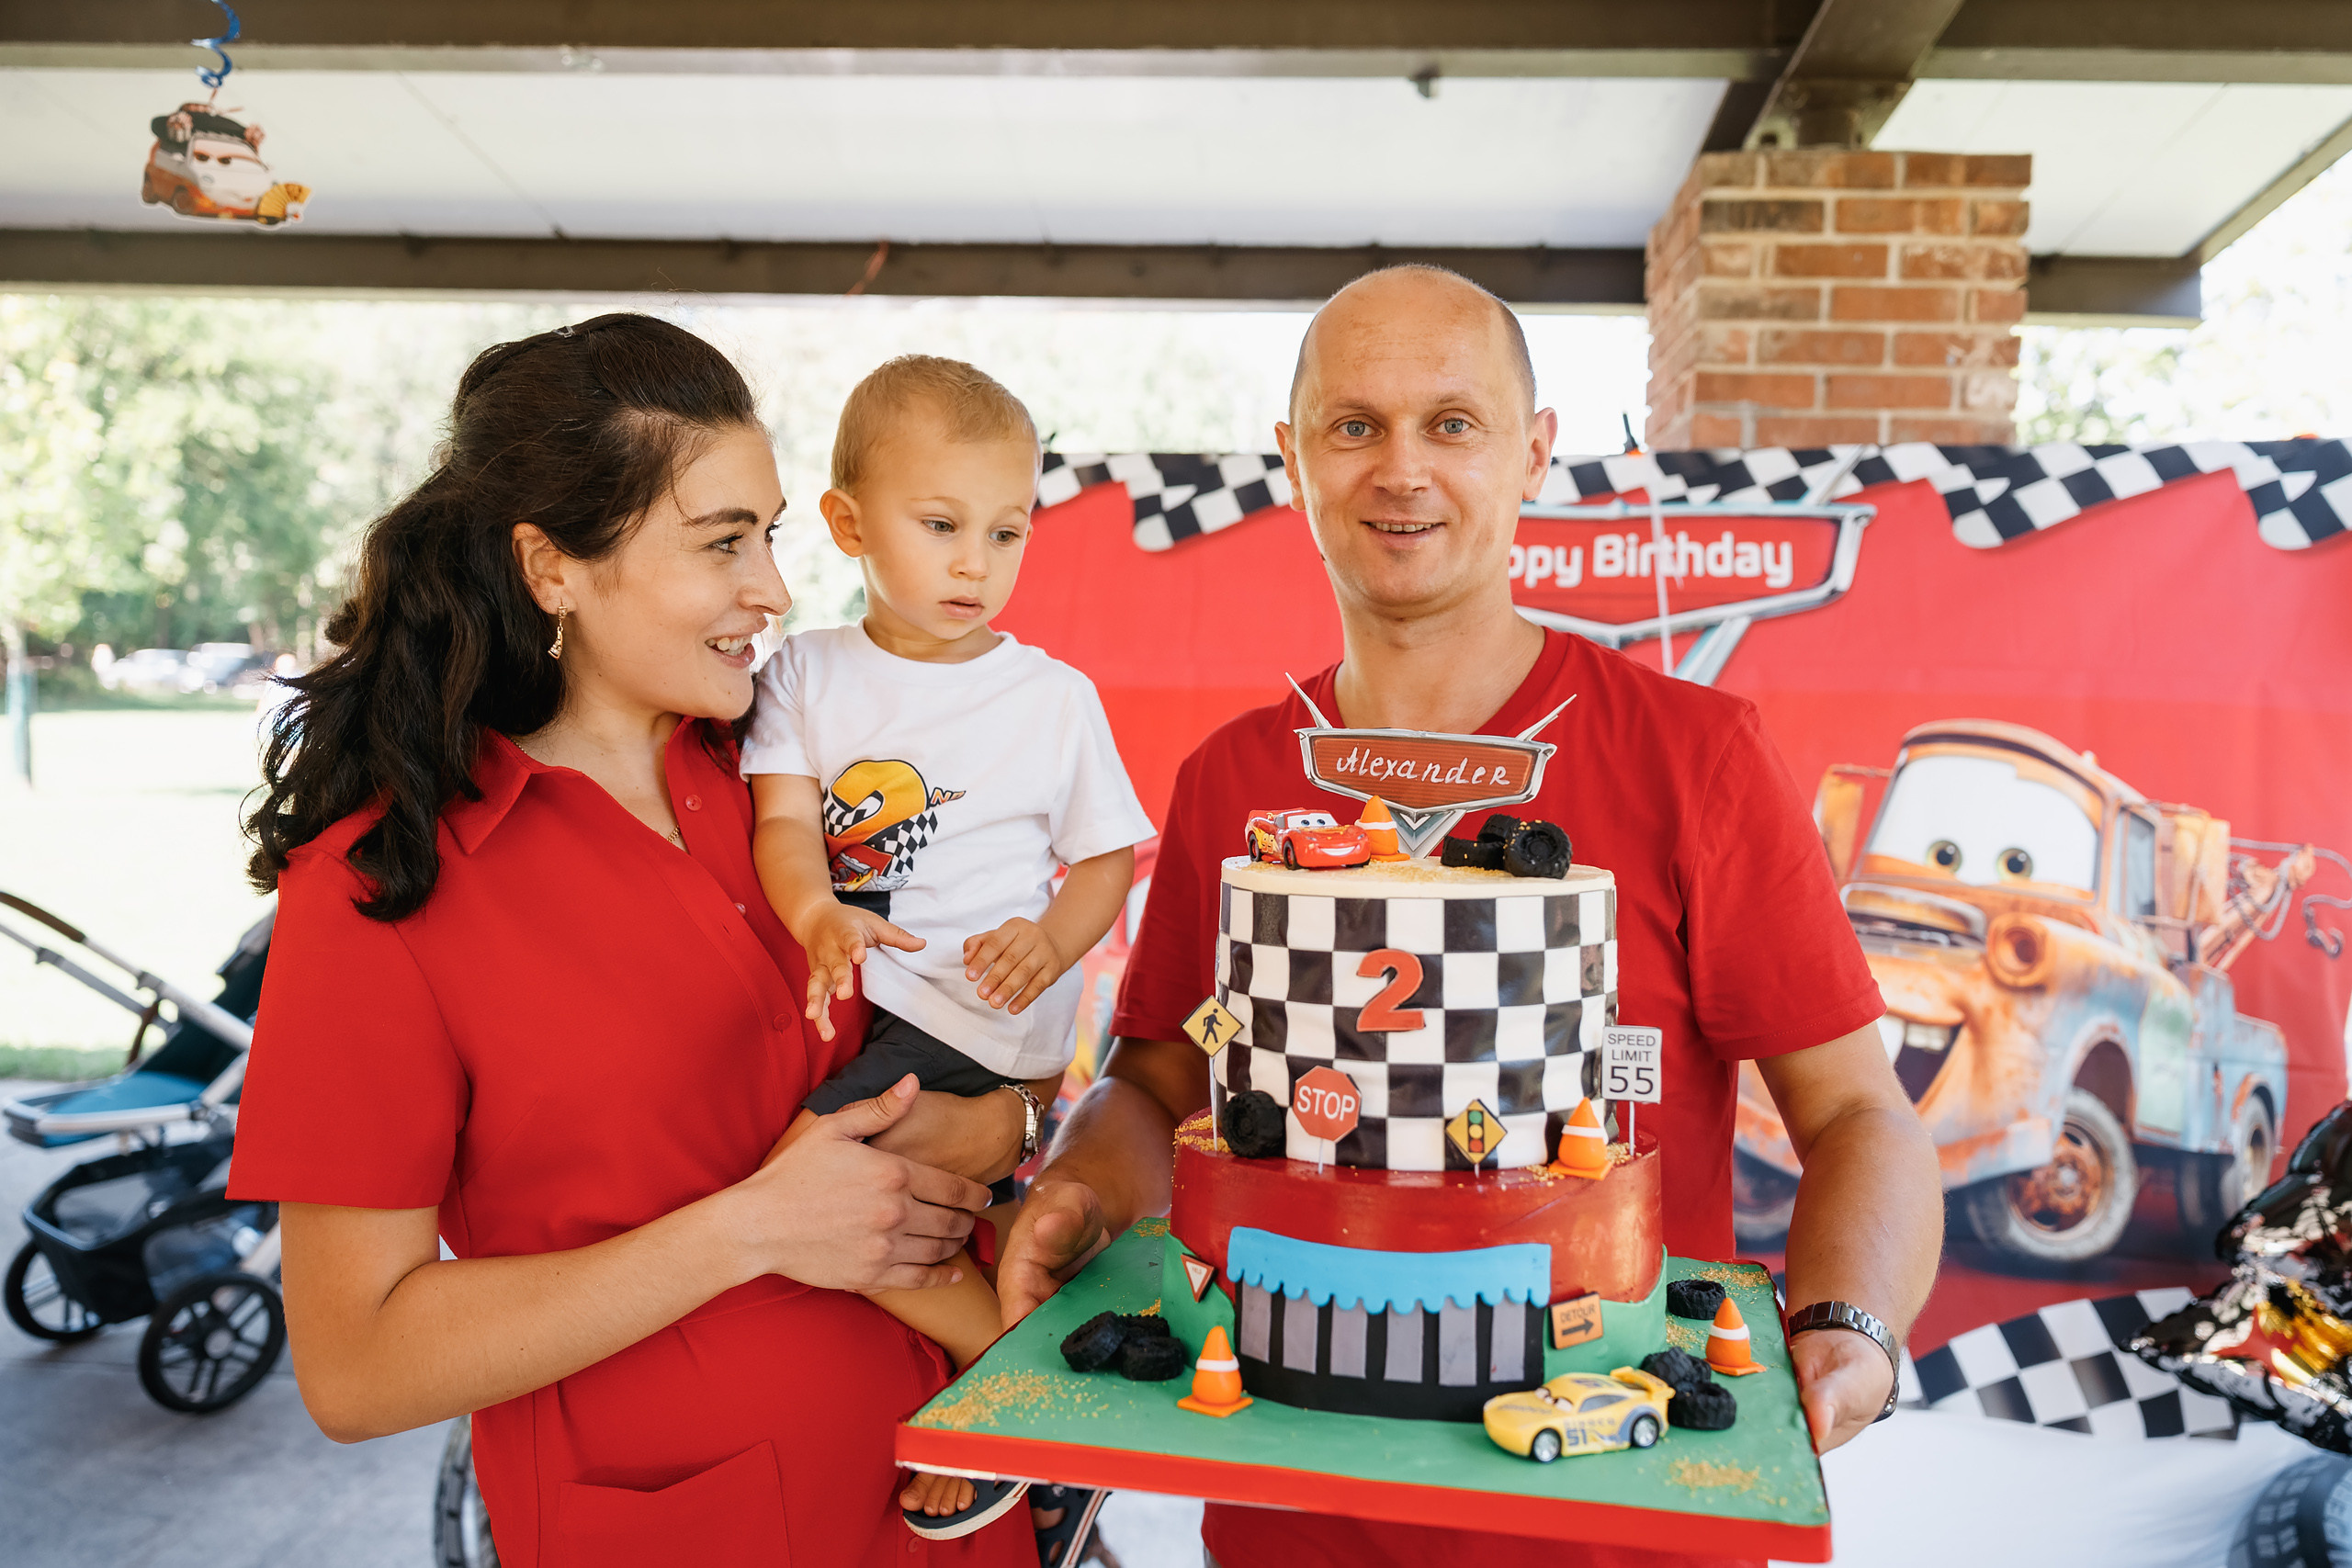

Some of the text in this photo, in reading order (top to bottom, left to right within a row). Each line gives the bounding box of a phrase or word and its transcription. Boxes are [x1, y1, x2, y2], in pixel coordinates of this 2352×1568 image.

[1509, 531, 1793, 589] ppy Birthday
[1356, 948, 1426, 1032] 2
[1607, 1033, 1656, 1046] SPEED
[1611, 1049, 1652, 1062] LIMIT
[1609, 1066, 1654, 1095] 55
[1296, 1085, 1356, 1122] STOP
[1560, 1304, 1596, 1324] DETOUR
[1566, 1428, 1588, 1446] 51
